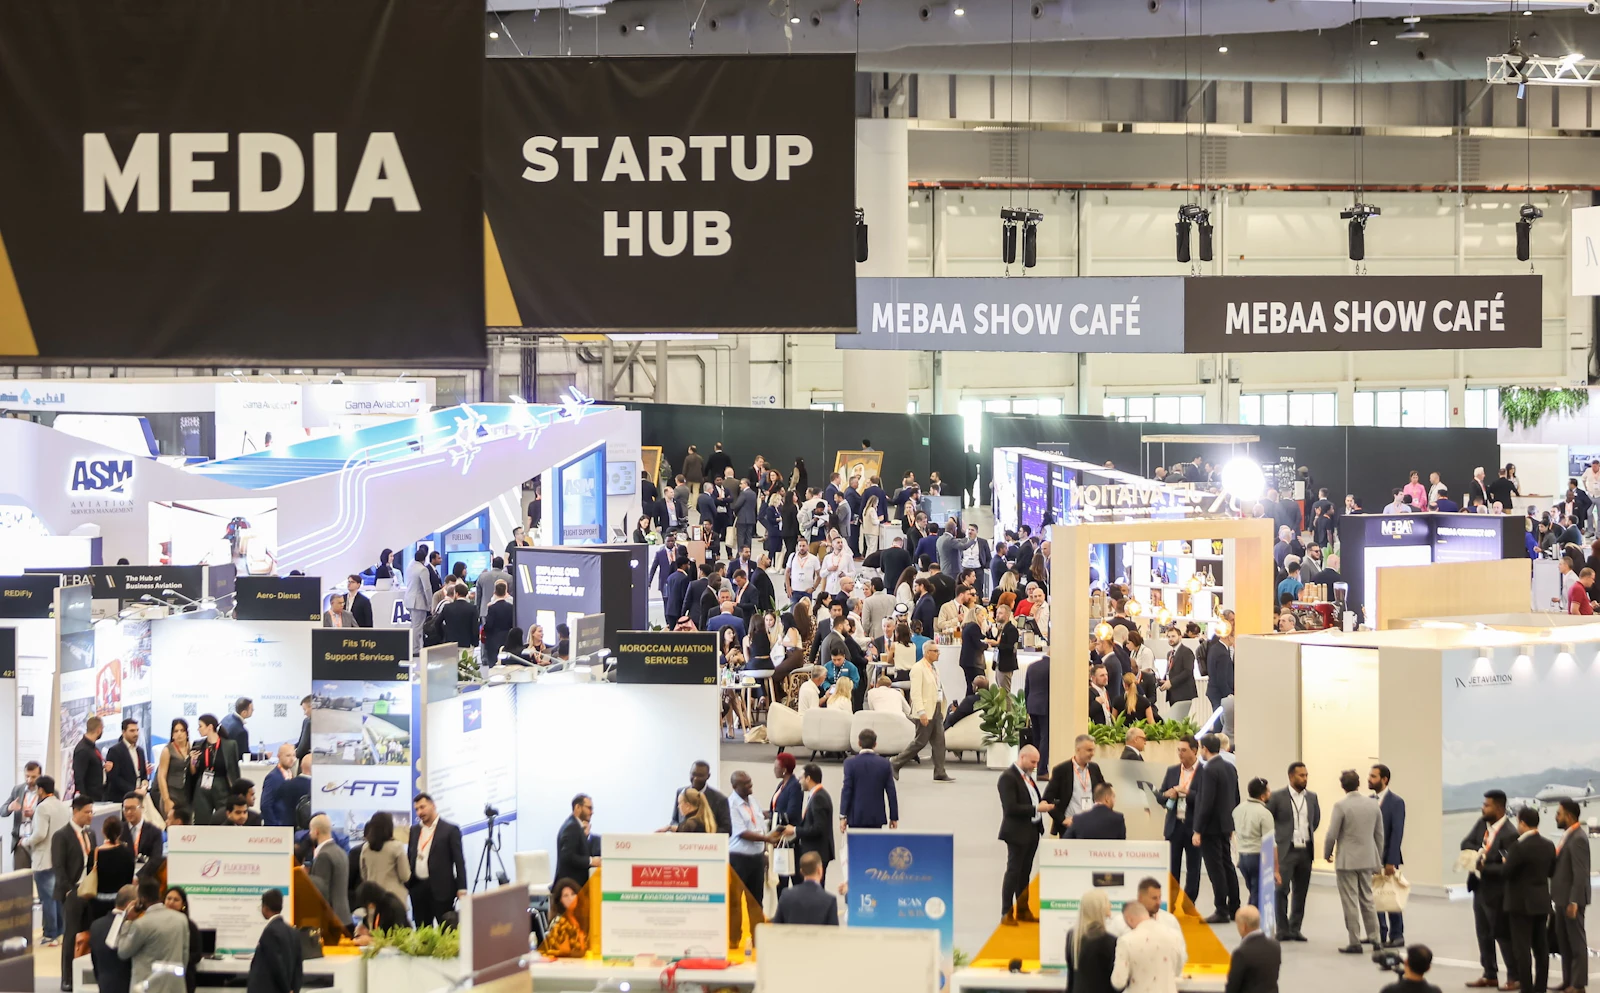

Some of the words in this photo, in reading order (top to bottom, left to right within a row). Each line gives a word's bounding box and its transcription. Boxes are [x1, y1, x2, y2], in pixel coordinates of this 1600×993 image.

[521, 134, 814, 183] STARTUP
[82, 131, 421, 213] MEDIA
[602, 210, 733, 257] HUB
[871, 303, 966, 335] MEBAA
[973, 302, 1062, 336] SHOW
[1069, 296, 1141, 336] CAFÉ
[1225, 301, 1327, 334] MEBAA
[1333, 300, 1425, 333] SHOW
[1431, 292, 1506, 333] CAFÉ
[344, 400, 371, 410] Gama
[372, 400, 410, 409] Aviation
[71, 460, 133, 493] ASM
[71, 500, 135, 508] AVIATION
[139, 574, 153, 582] Hub
[256, 591, 276, 599] Aero-
[277, 591, 301, 599] Dienst
[342, 639, 358, 648] Fits
[360, 639, 376, 649] Trip
[619, 644, 672, 653] MOROCCAN
[672, 644, 714, 653] AVIATION
[324, 652, 358, 662] Support
[359, 652, 395, 661] Services
[644, 656, 689, 665] SERVICES
[1468, 676, 1481, 684] JET
[1481, 674, 1513, 683] AVIATION
[181, 835, 197, 843] 407
[1053, 848, 1069, 857] 314
[1088, 850, 1115, 858] TRAVEL
[1125, 850, 1160, 858] TOURISM
[640, 866, 689, 879] AWERY
[620, 893, 642, 901] AWERY
[643, 893, 674, 901] AVIATION
[675, 893, 710, 902] SOFTWARE
[860, 893, 872, 907] 15
